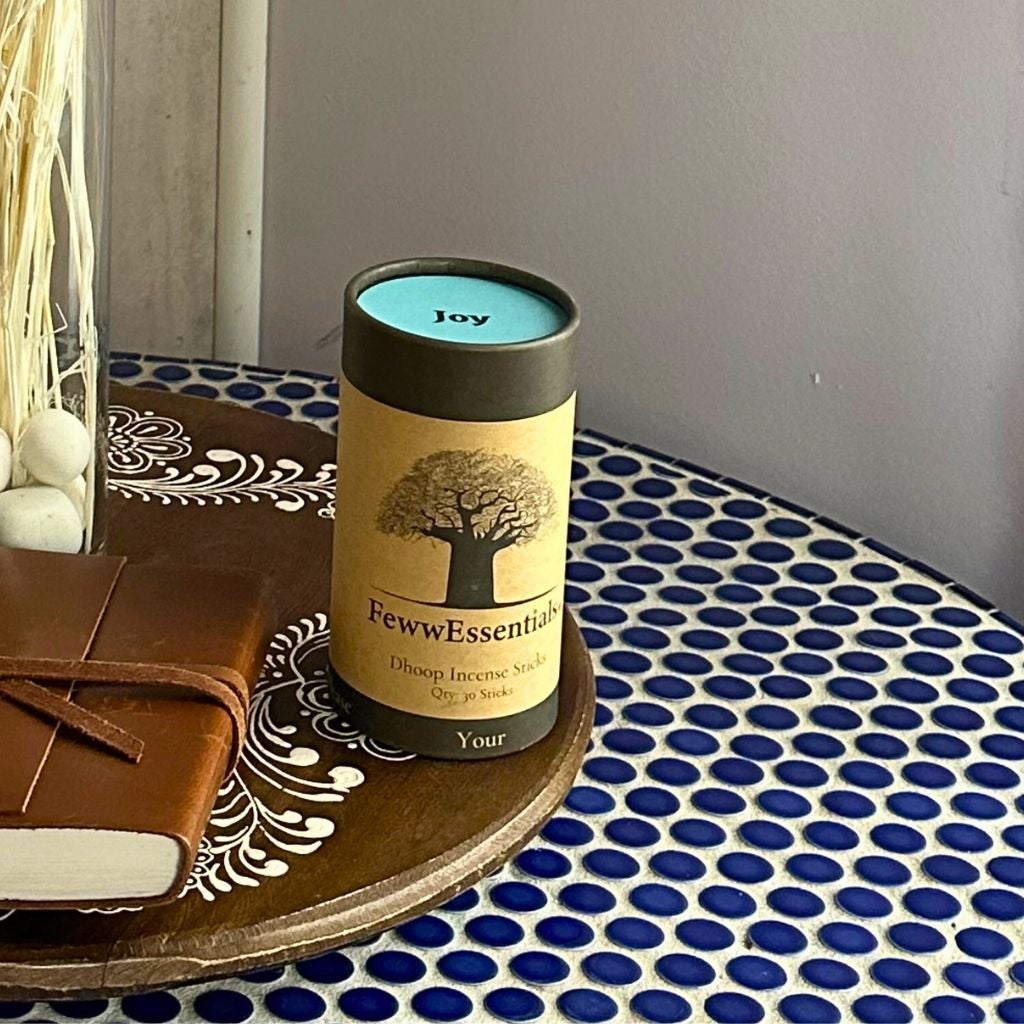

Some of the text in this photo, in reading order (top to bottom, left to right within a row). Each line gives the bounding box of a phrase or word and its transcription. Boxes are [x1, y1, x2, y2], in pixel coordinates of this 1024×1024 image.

[432, 309, 491, 327] Joy
[389, 652, 547, 684] Dhoop Incense Sticks
[463, 691, 477, 703] 30
[480, 685, 513, 700] Sticks
[457, 731, 507, 749] Your
